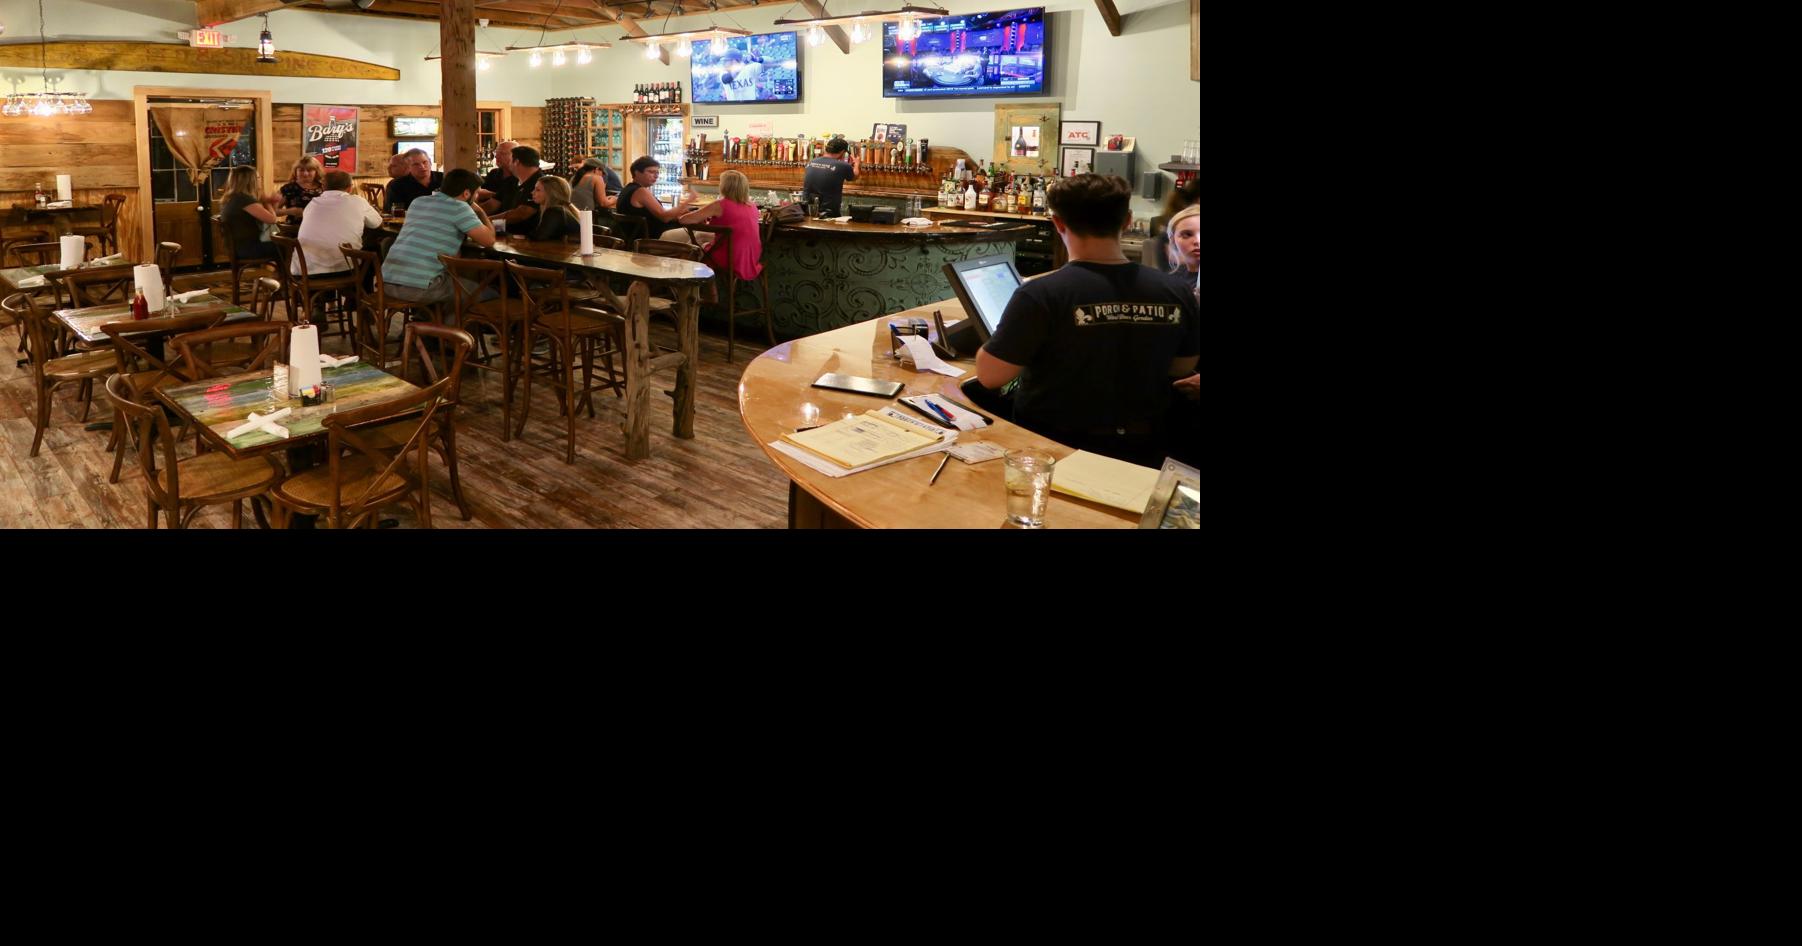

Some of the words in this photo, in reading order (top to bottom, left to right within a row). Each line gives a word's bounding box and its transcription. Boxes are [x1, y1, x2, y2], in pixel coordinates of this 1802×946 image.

[196, 31, 218, 45] EXIT
[694, 117, 714, 125] WINE
[1121, 304, 1131, 313] &
[1132, 304, 1165, 318] PATIO
